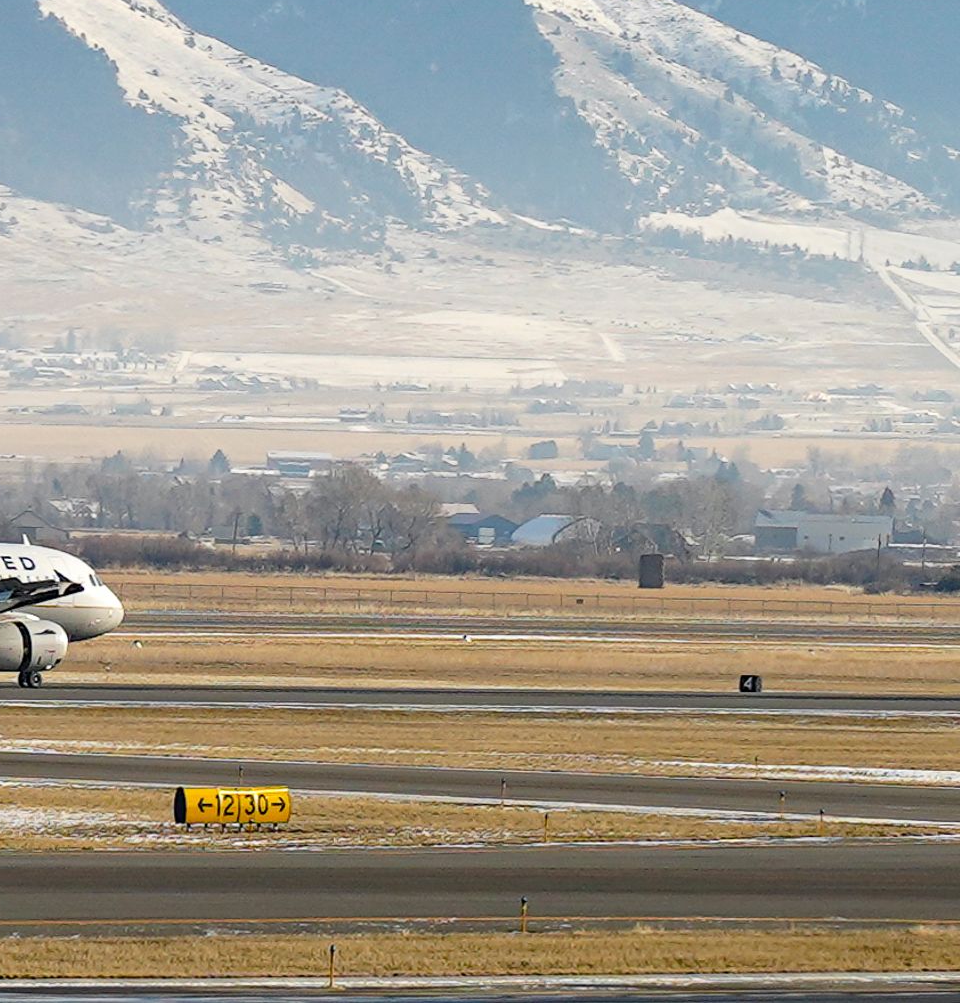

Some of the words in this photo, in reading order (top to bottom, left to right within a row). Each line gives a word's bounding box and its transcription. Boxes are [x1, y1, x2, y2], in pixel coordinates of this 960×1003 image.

[743, 676, 753, 691] 4
[215, 794, 235, 817] 12
[244, 794, 269, 816] 30
